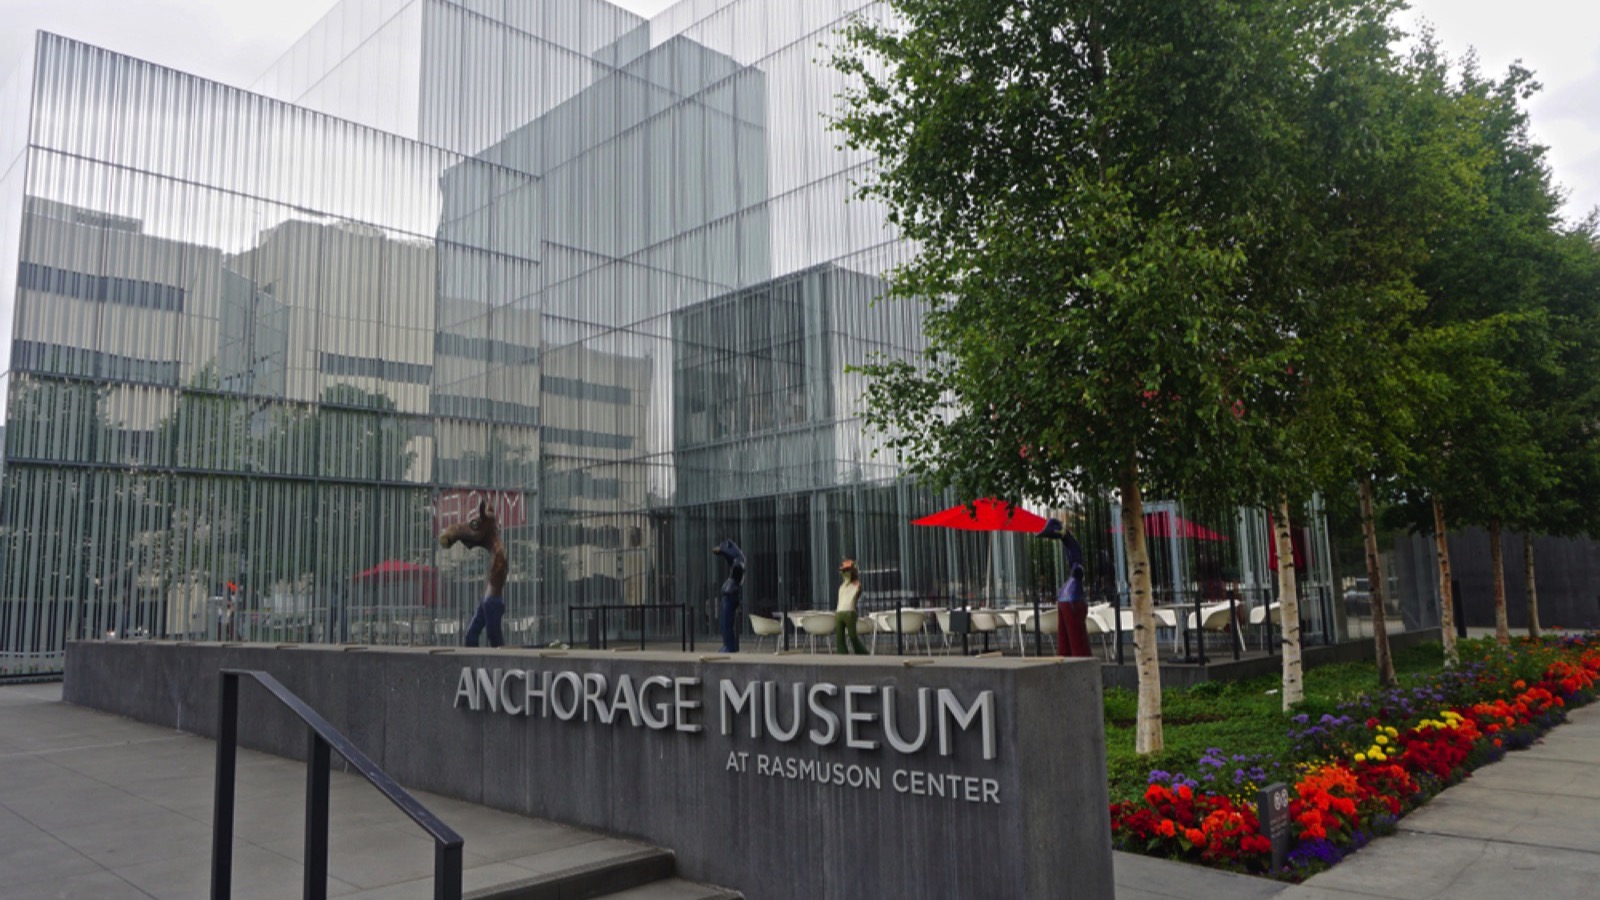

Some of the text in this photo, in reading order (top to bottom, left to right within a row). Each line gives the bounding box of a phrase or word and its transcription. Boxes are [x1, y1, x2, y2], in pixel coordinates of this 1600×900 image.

[453, 666, 997, 760] ANCHORAGE MUSEUM
[726, 751, 1001, 803] AT RASMUSON CENTER
